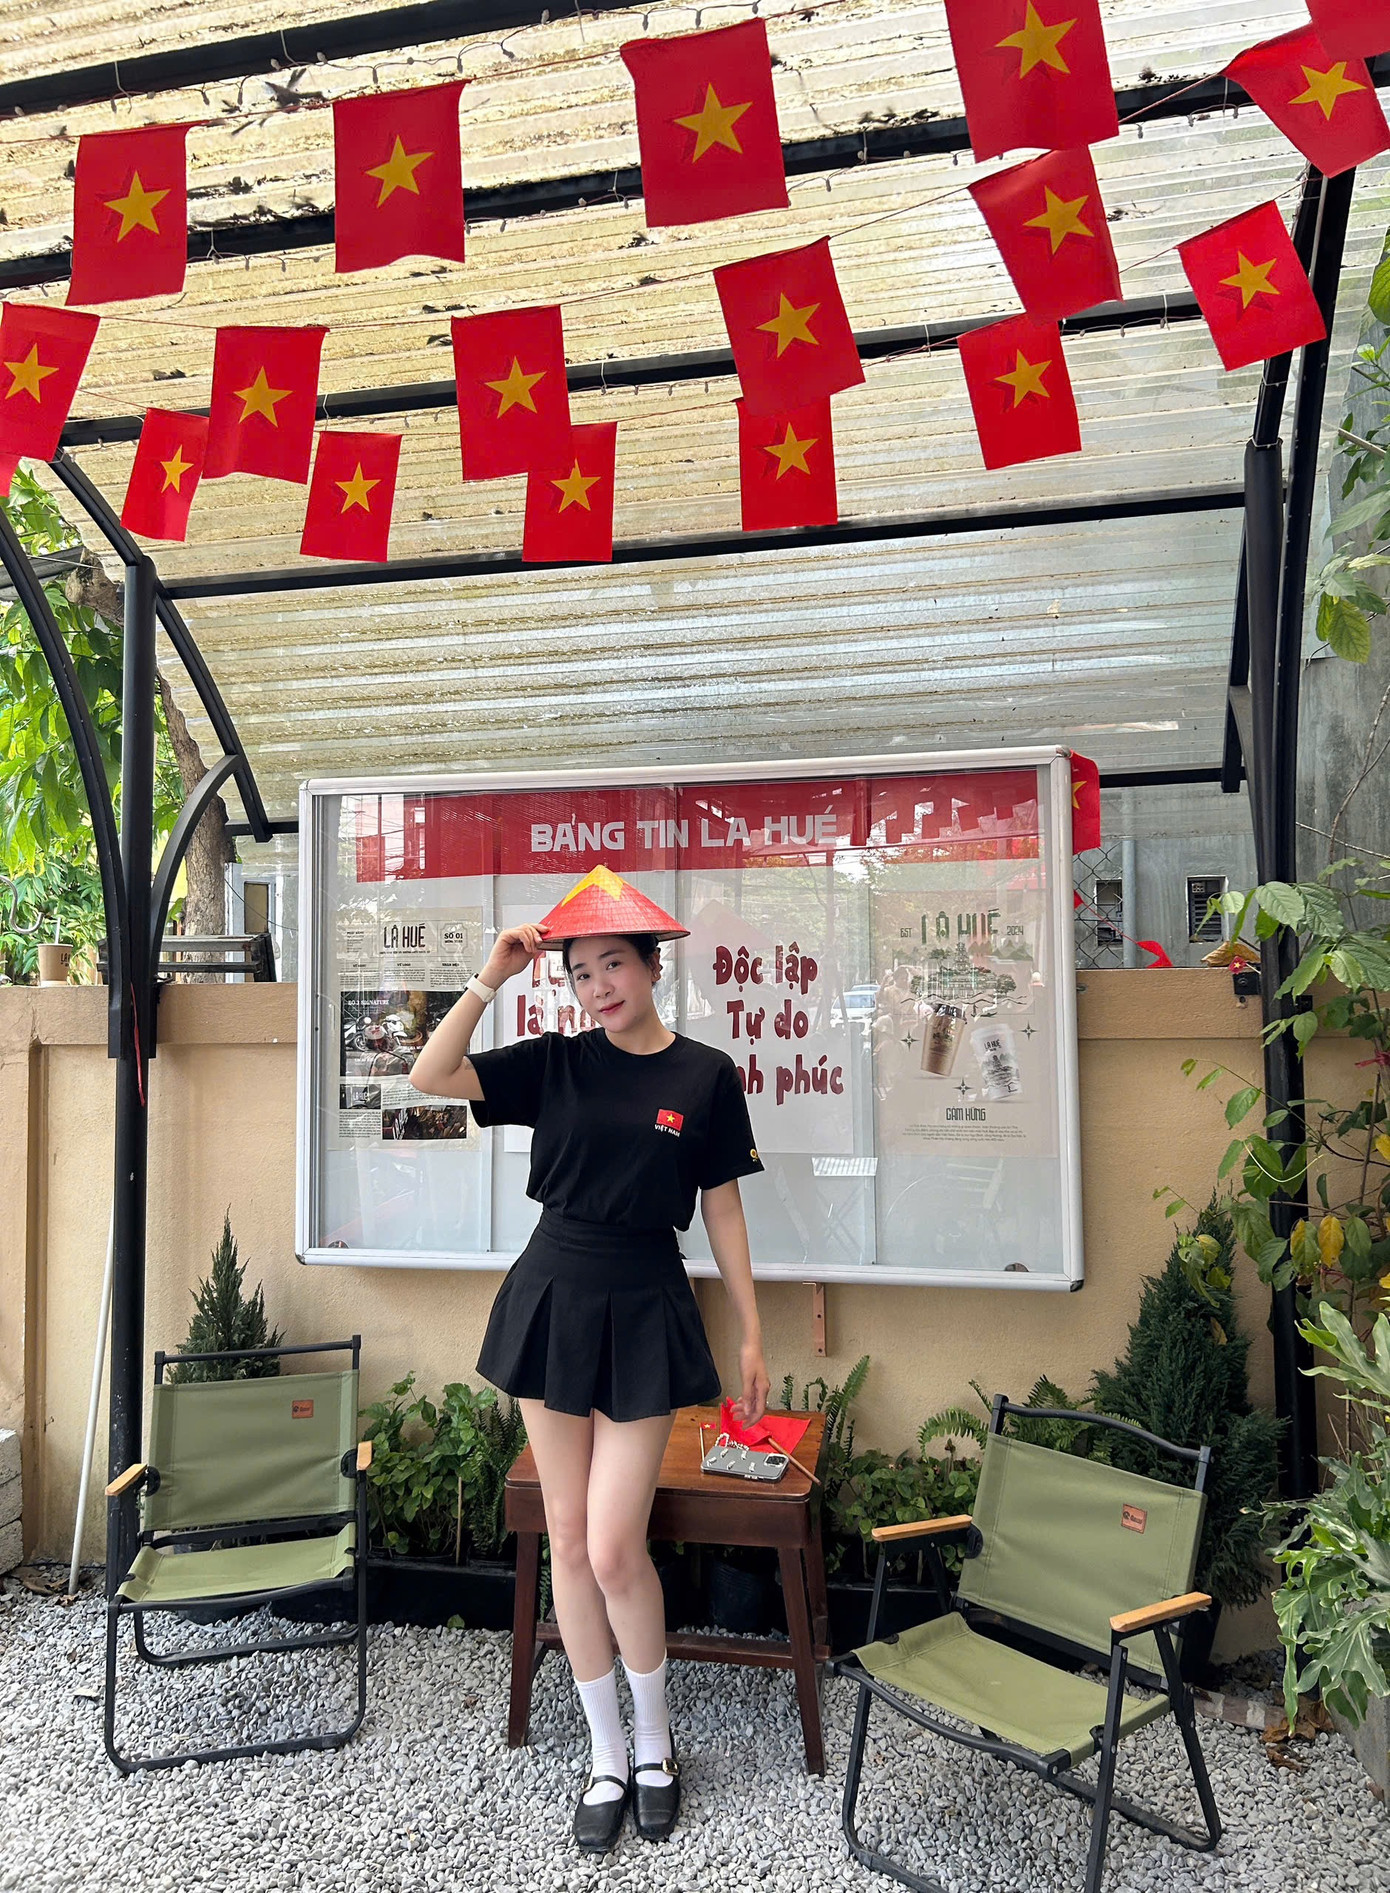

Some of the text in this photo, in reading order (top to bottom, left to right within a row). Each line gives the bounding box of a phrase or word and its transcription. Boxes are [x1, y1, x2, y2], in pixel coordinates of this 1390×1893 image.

[531, 813, 625, 852] BẢNG
[637, 818, 689, 849] TIN
[712, 941, 818, 995] Độc lập
[726, 999, 808, 1045] Tự do
[776, 1054, 844, 1105] phúc
[654, 1123, 680, 1137] VIỆT NAM
